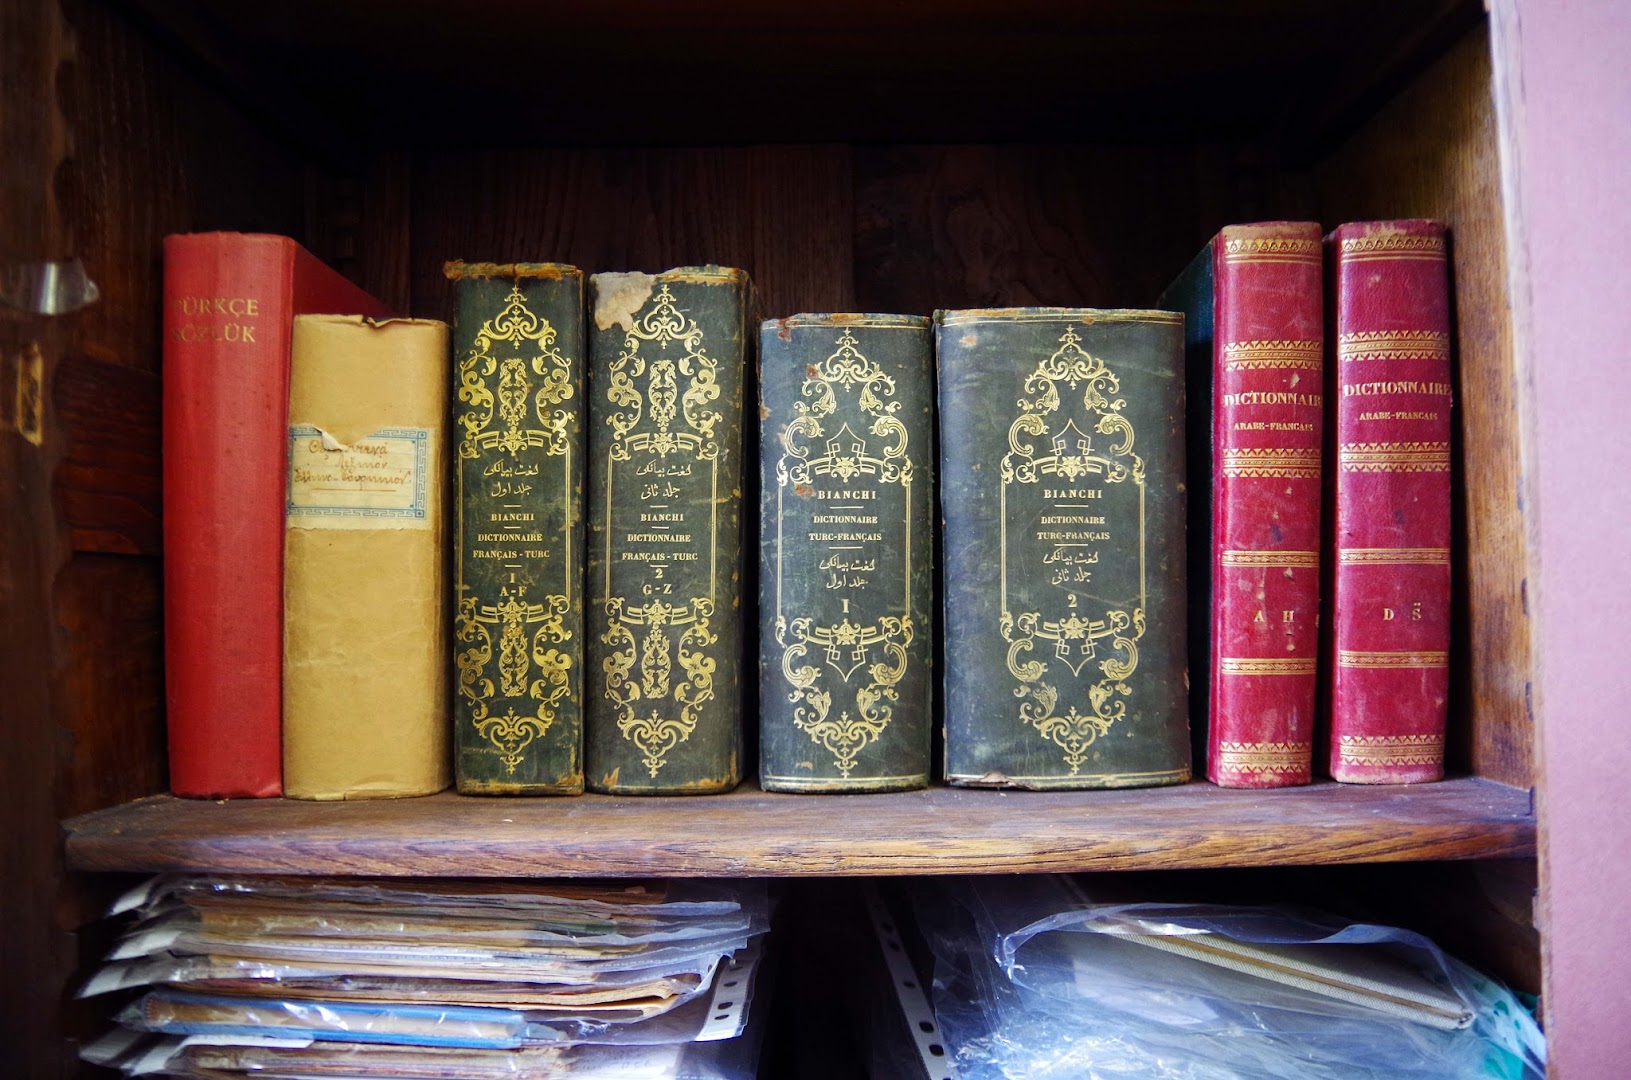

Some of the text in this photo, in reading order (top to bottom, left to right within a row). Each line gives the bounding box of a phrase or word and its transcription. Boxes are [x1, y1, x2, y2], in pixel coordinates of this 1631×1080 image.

[1343, 381, 1451, 398] DICTIONNAIRE
[1224, 391, 1321, 407] DICTIONNAIR
[817, 490, 877, 500] BIANCHI
[1043, 489, 1103, 499] BIANCHI
[490, 513, 535, 522] BIANCHI
[640, 513, 684, 522] BIANCHI
[813, 515, 878, 524] DICTIONNAIRE
[1040, 516, 1106, 525] DICTIONNAIRE
[477, 533, 543, 542] DICTIONNAIRE
[627, 533, 691, 543] DICTIONNAIRE
[808, 532, 882, 543] TURC-FRANÇAIS
[1036, 531, 1111, 542] TURC-FRANÇAIS
[654, 567, 664, 579] 2
[1067, 593, 1078, 608] 2
[1253, 610, 1295, 623] A H
[1383, 608, 1395, 621] D
